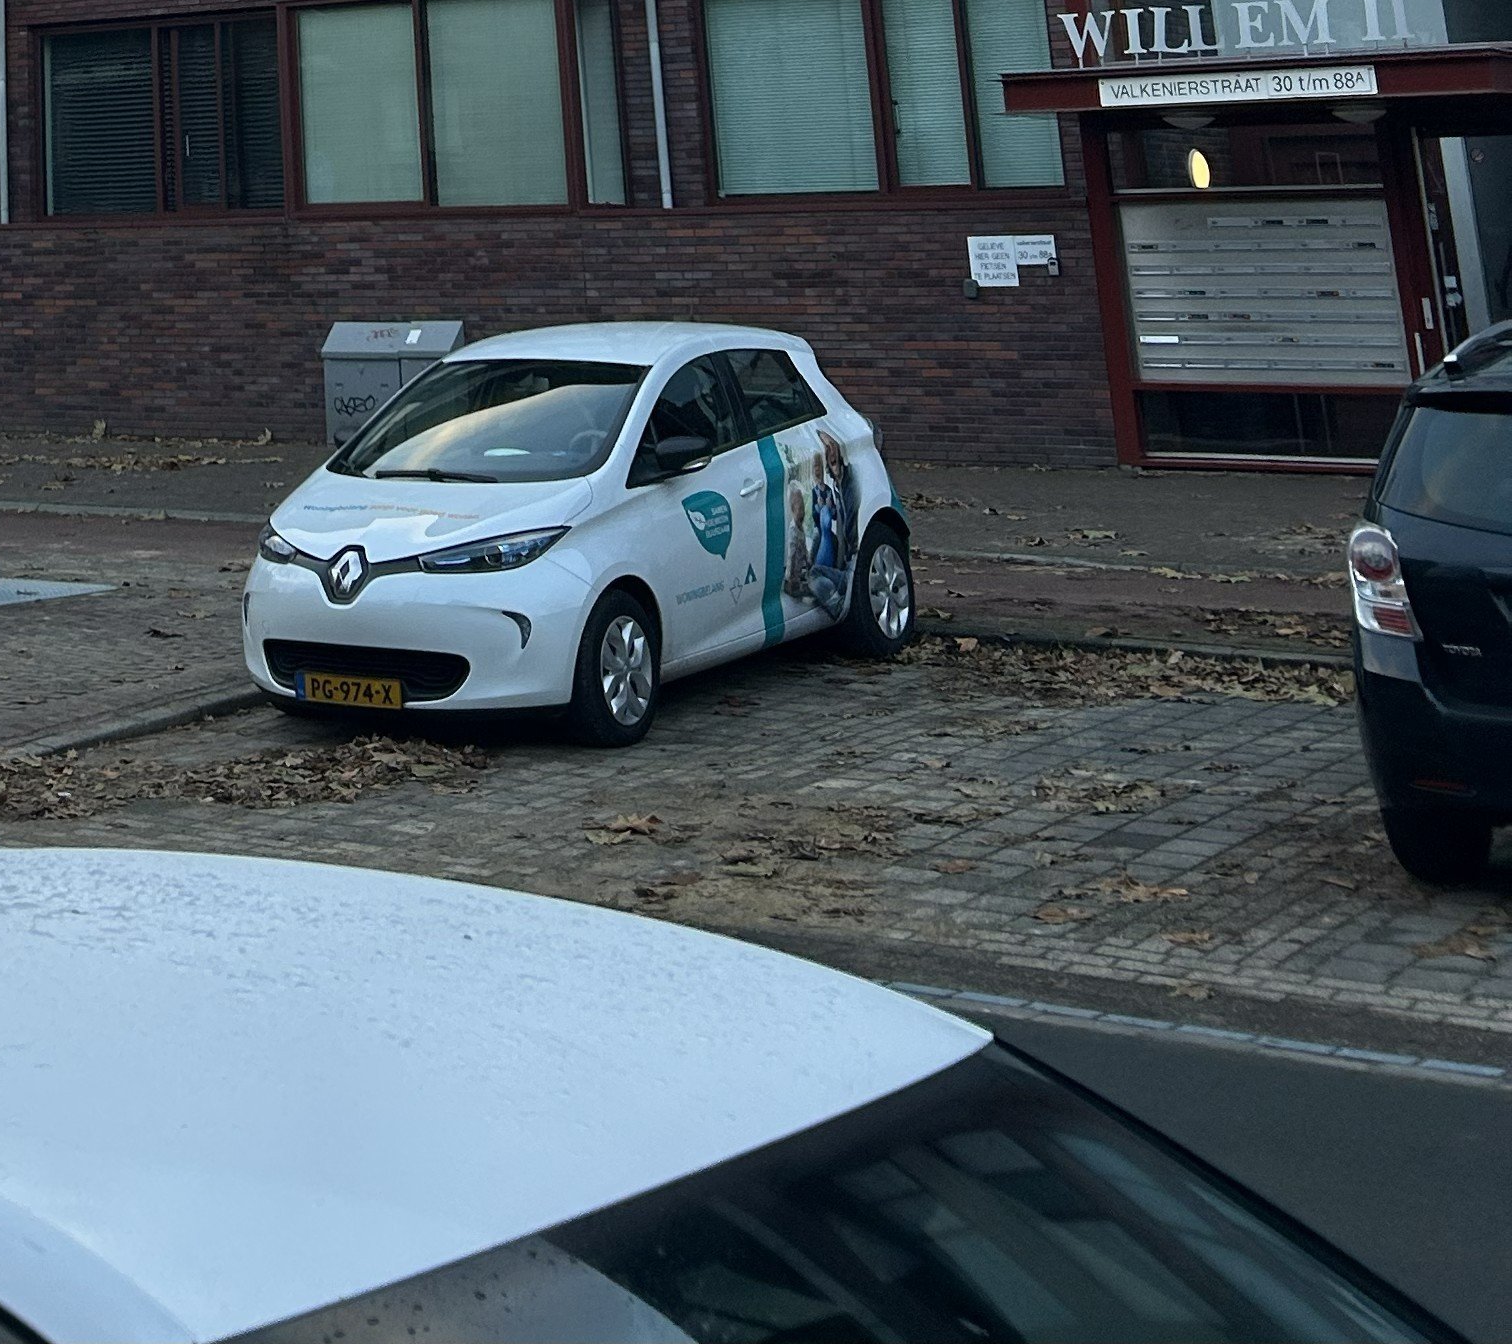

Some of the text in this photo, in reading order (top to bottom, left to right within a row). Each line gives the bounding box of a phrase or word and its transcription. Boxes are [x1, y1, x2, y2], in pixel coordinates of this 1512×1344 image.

[1110, 77, 1262, 99] VALKENIERSTRAAT
[1272, 75, 1293, 93] 30
[1298, 73, 1329, 91] t/m
[991, 252, 1010, 260] GEEN
[1017, 250, 1029, 260] 30
[310, 677, 394, 705] PG-974-X
